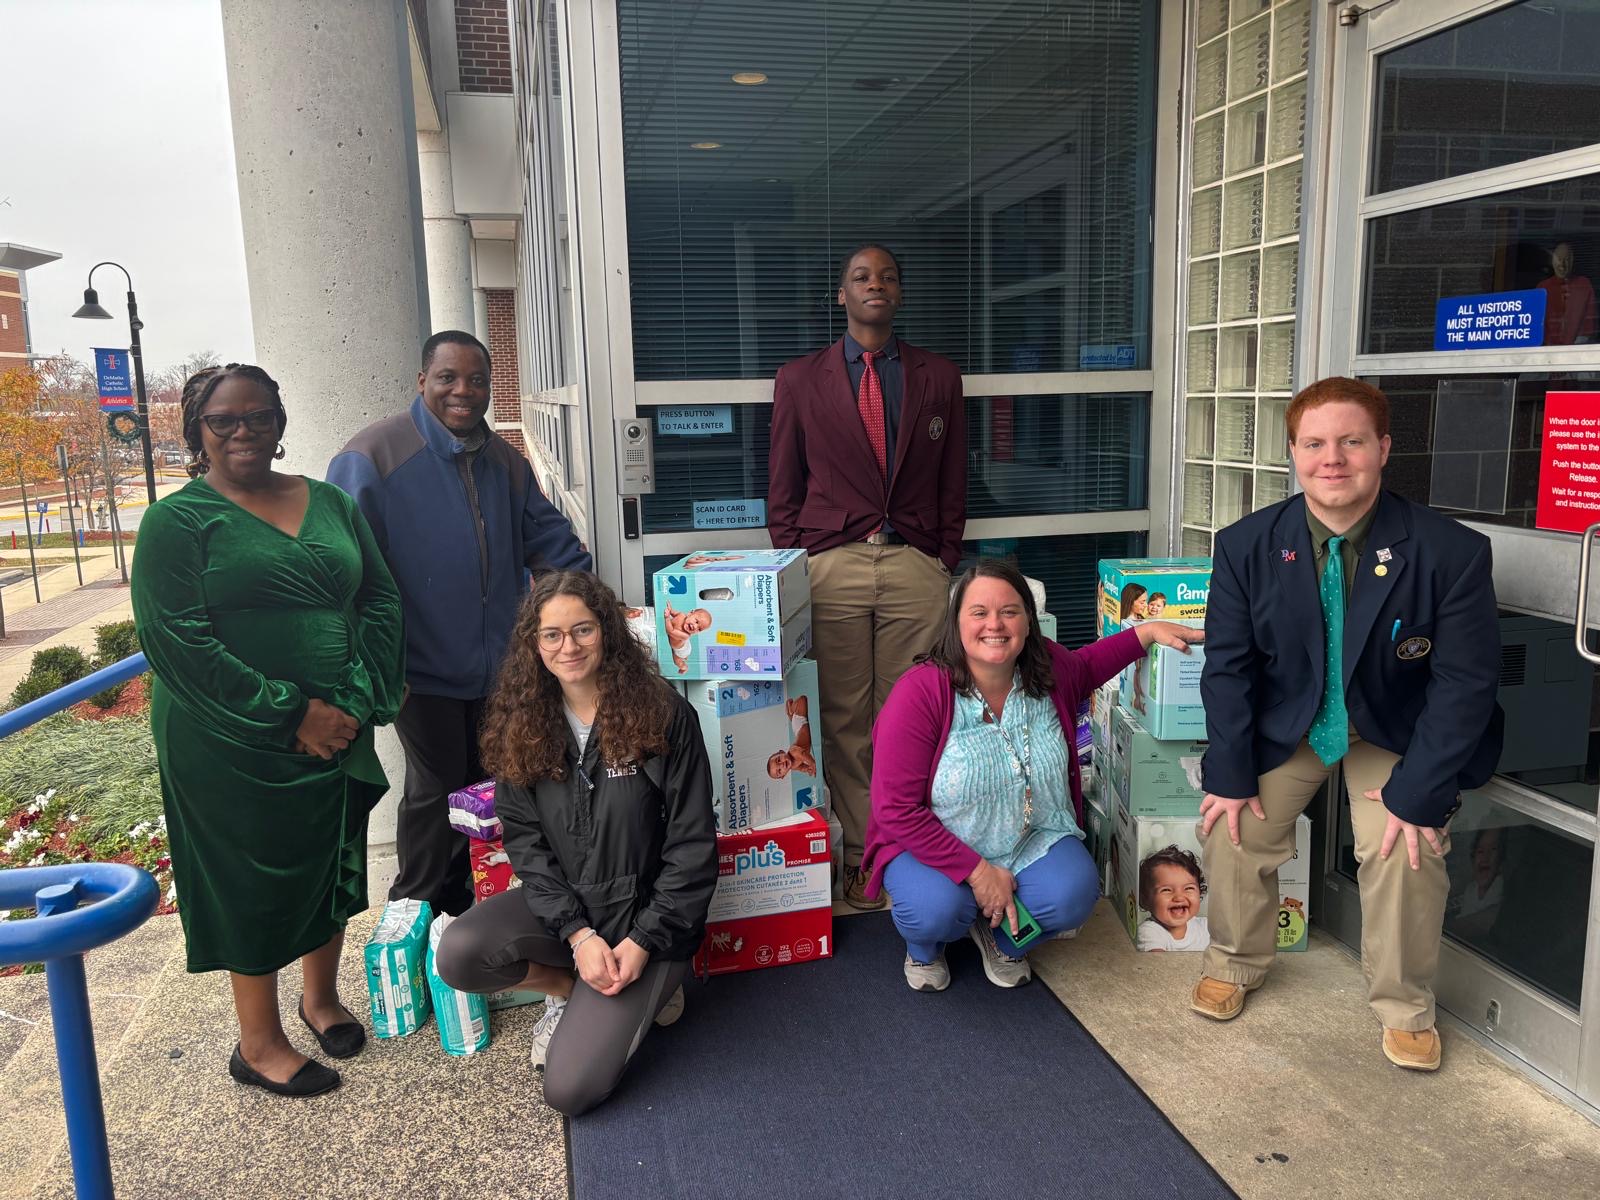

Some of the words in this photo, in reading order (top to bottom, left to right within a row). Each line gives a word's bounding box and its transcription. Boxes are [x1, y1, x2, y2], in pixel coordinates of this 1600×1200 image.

[1458, 304, 1475, 316] ALL
[1478, 300, 1522, 314] VISITORS
[1446, 318, 1473, 330] MUST
[1476, 315, 1515, 328] REPORT
[1518, 313, 1532, 326] TO
[1447, 332, 1465, 343] THE
[1468, 330, 1492, 342] MAIN
[1494, 328, 1531, 340] OFFICE
[1117, 348, 1135, 359] ADT
[1549, 417, 1568, 425] When
[1569, 418, 1580, 426] the
[1581, 418, 1596, 426] door
[1549, 430, 1571, 438] please
[1571, 431, 1584, 439] use
[1556, 443, 1580, 451] system
[1580, 443, 1587, 451] to
[1552, 460, 1569, 468] Push
[1570, 461, 1581, 469] the
[1569, 472, 1598, 483] Release.
[1551, 487, 1566, 495] Wait
[1567, 488, 1576, 496] for
[1555, 499, 1568, 507] and
[756, 574, 764, 605] Diapers
[764, 574, 774, 620] Absorbent
[767, 624, 776, 643] Soft
[763, 664, 776, 672] 1
[722, 689, 734, 700] 2
[724, 734, 734, 758] Soft
[725, 759, 735, 769] &
[727, 771, 738, 829] Absorbent
[738, 784, 749, 828] Diapers
[719, 854, 734, 864] IES
[736, 845, 785, 875] plus
[786, 858, 811, 867] PROMISE
[736, 876, 766, 887] SKINCARE
[768, 871, 805, 881] PROTECTION
[718, 884, 756, 894] PROTECTION
[756, 880, 784, 890] CUTANÉE
[1278, 910, 1291, 928] 3
[818, 935, 829, 955] 1
